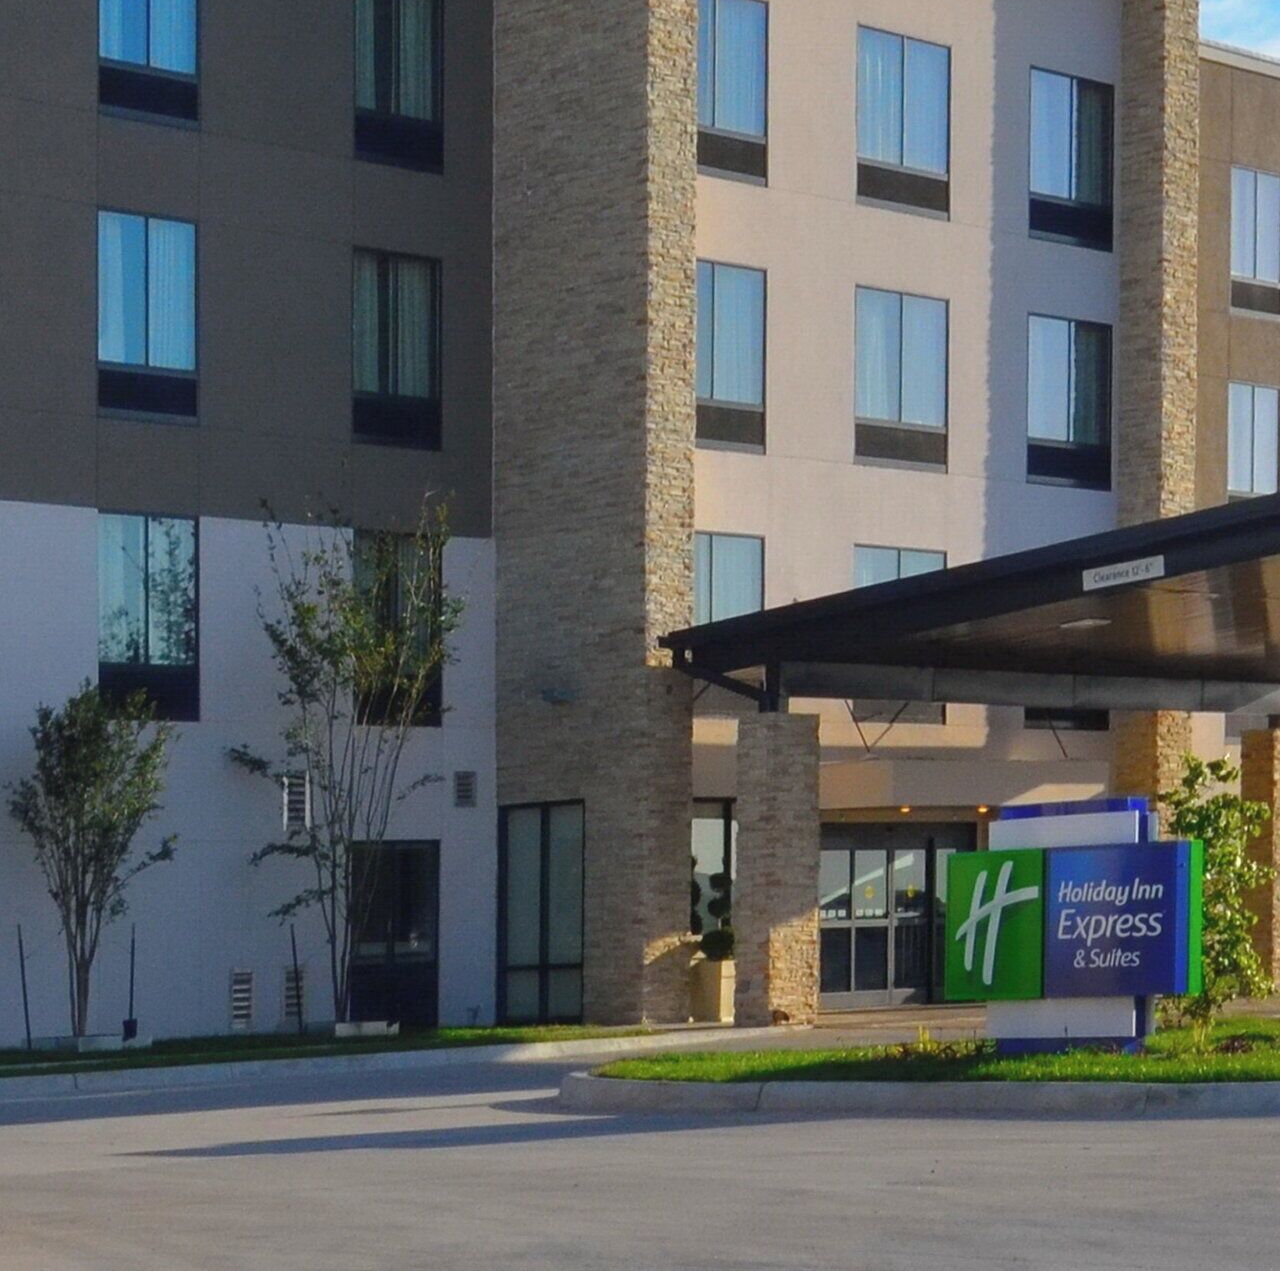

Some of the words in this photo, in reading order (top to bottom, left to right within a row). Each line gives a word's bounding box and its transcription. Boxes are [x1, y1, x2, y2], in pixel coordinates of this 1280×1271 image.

[1058, 879, 1130, 906] Holiday
[1132, 877, 1164, 900] Inn
[1057, 909, 1163, 947] Express
[1073, 949, 1086, 968] &
[1089, 948, 1141, 968] Suites
